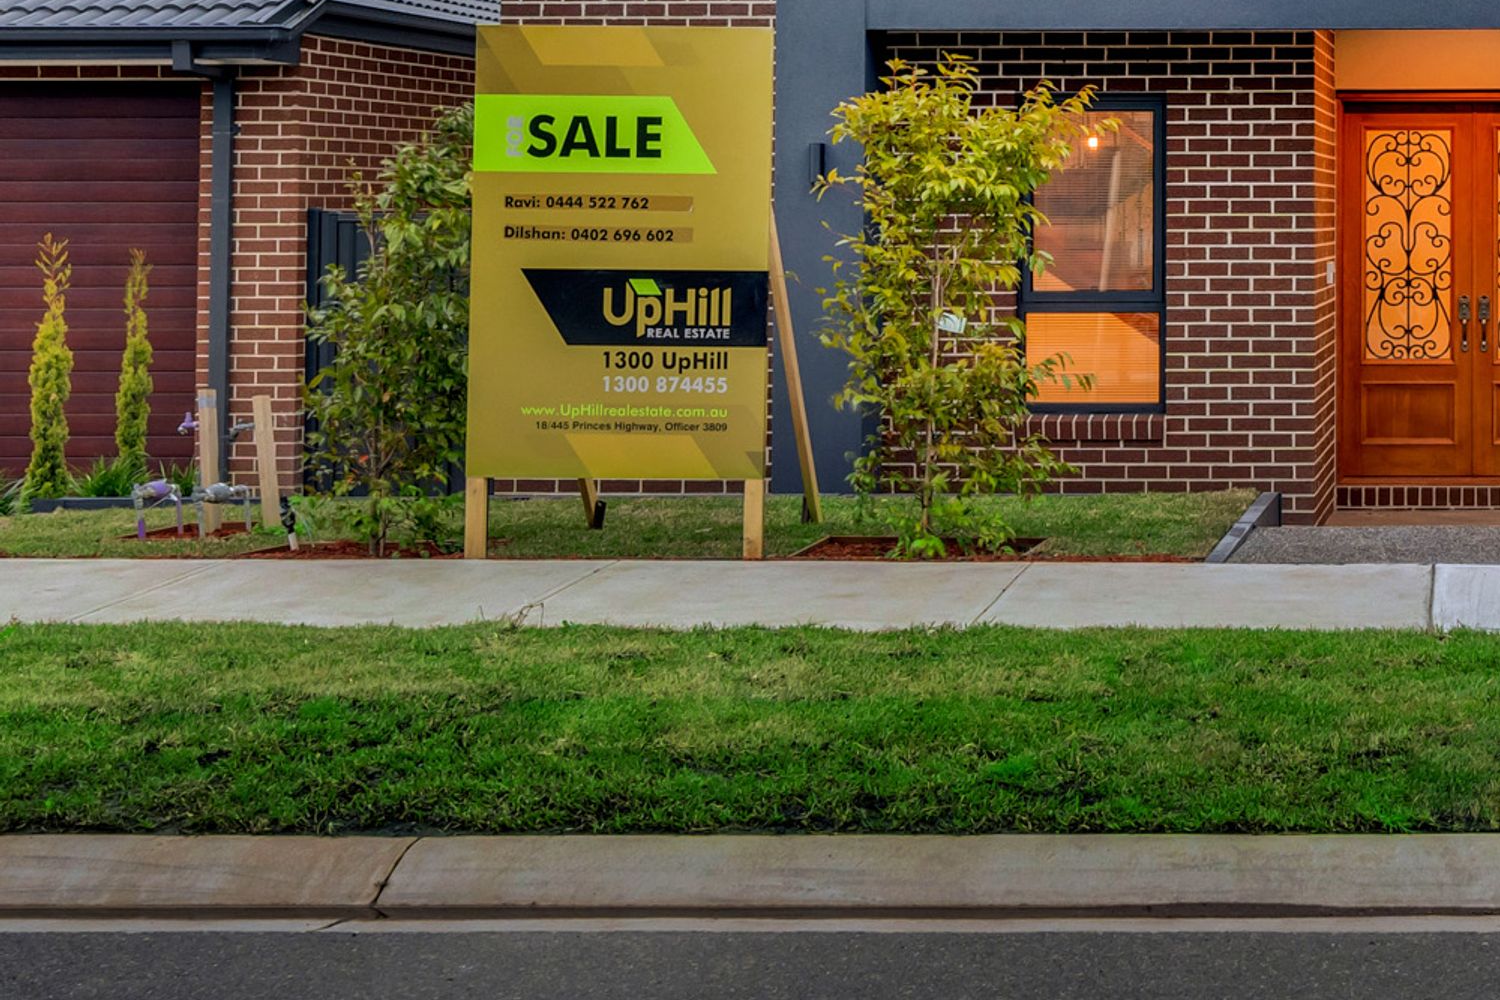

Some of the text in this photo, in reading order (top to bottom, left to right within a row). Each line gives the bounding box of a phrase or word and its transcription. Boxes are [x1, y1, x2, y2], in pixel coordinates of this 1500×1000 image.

[506, 116, 524, 157] FOR
[526, 113, 662, 158] SALE
[504, 195, 649, 210] Ravi: 0444 522 762
[503, 226, 674, 242] Dilshan: 0402 696 602
[602, 282, 732, 338] UpHill
[646, 327, 731, 339] REAL ESTATE
[602, 351, 728, 374] 1300 UpHill
[602, 376, 728, 394] 1300 874455
[520, 403, 728, 419] www.UpHillrealestate.com.au
[572, 420, 612, 431] Princes
[614, 421, 662, 433] Highway,
[664, 422, 700, 432] Officer
[702, 422, 728, 432] 3809
